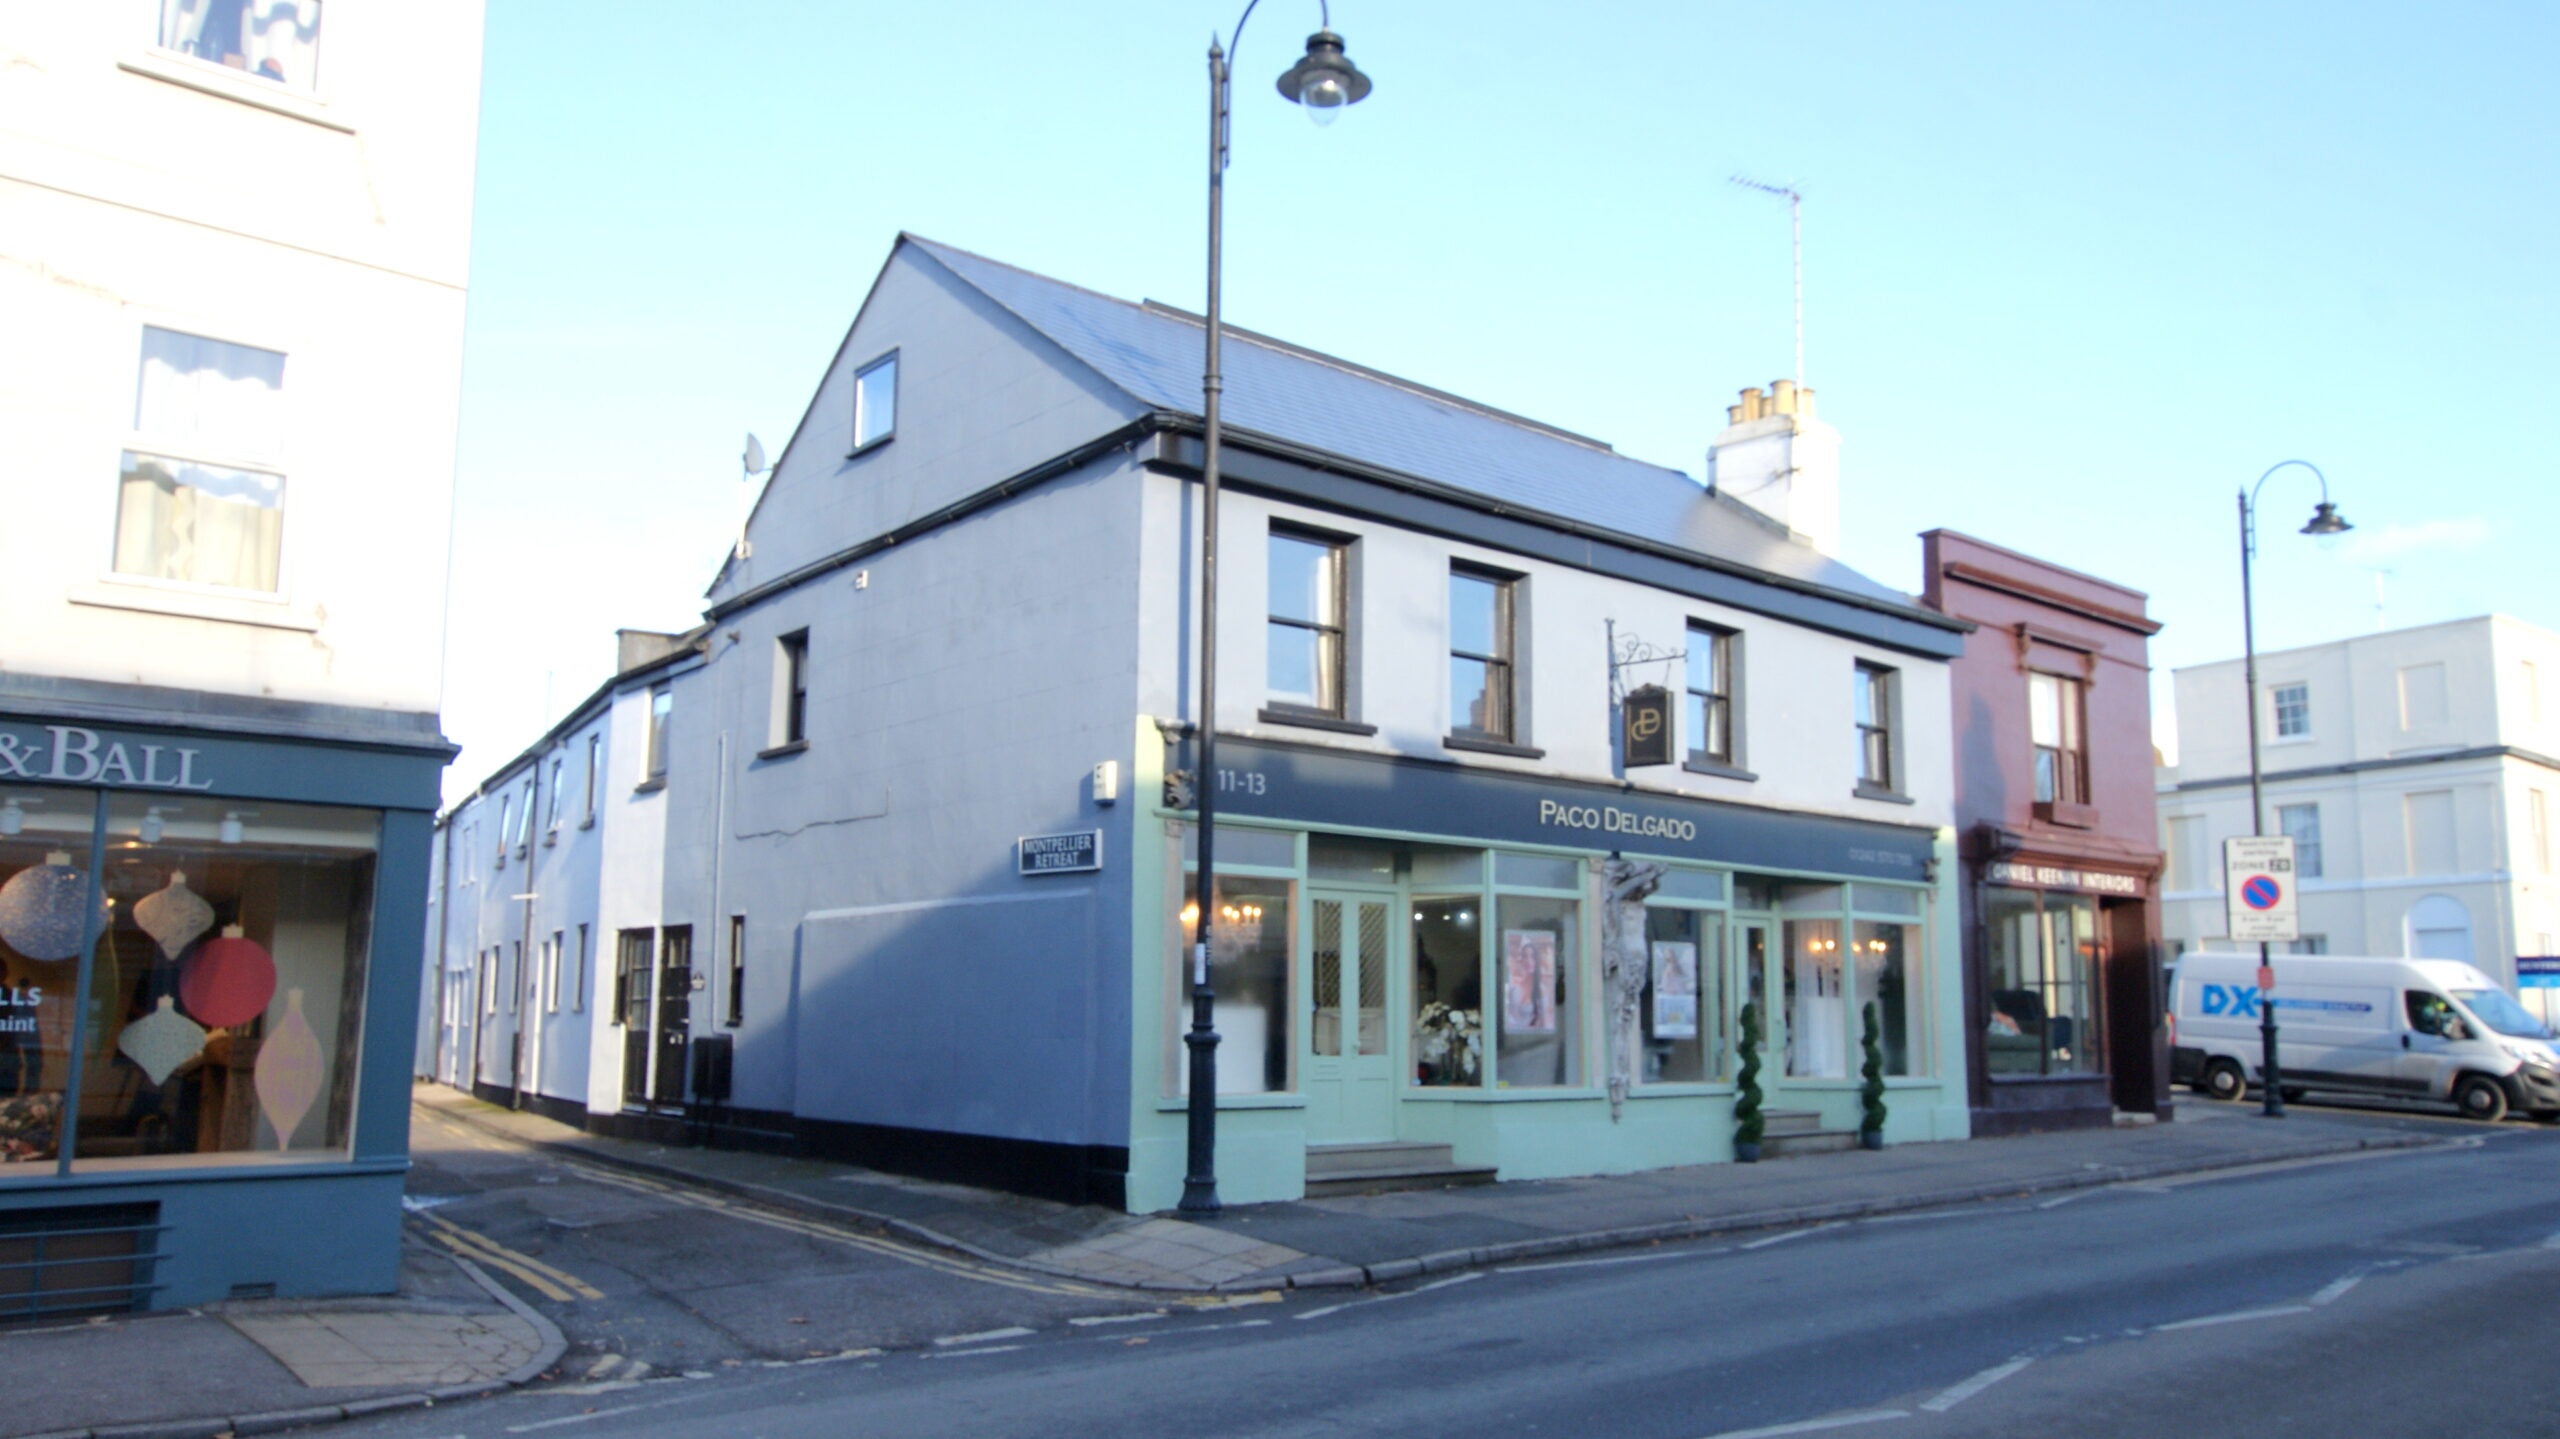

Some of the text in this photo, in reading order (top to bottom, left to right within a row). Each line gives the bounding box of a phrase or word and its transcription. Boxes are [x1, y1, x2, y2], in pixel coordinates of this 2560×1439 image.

[38, 725, 214, 790] BALL
[1218, 769, 1266, 796] 11-13
[1540, 799, 1696, 841] PACO DELGADO
[1023, 835, 1092, 854] MONTPELLIER
[1035, 851, 1079, 869] RETREAT
[2082, 872, 2135, 893] INTERIORS
[2202, 984, 2258, 1017] DX
